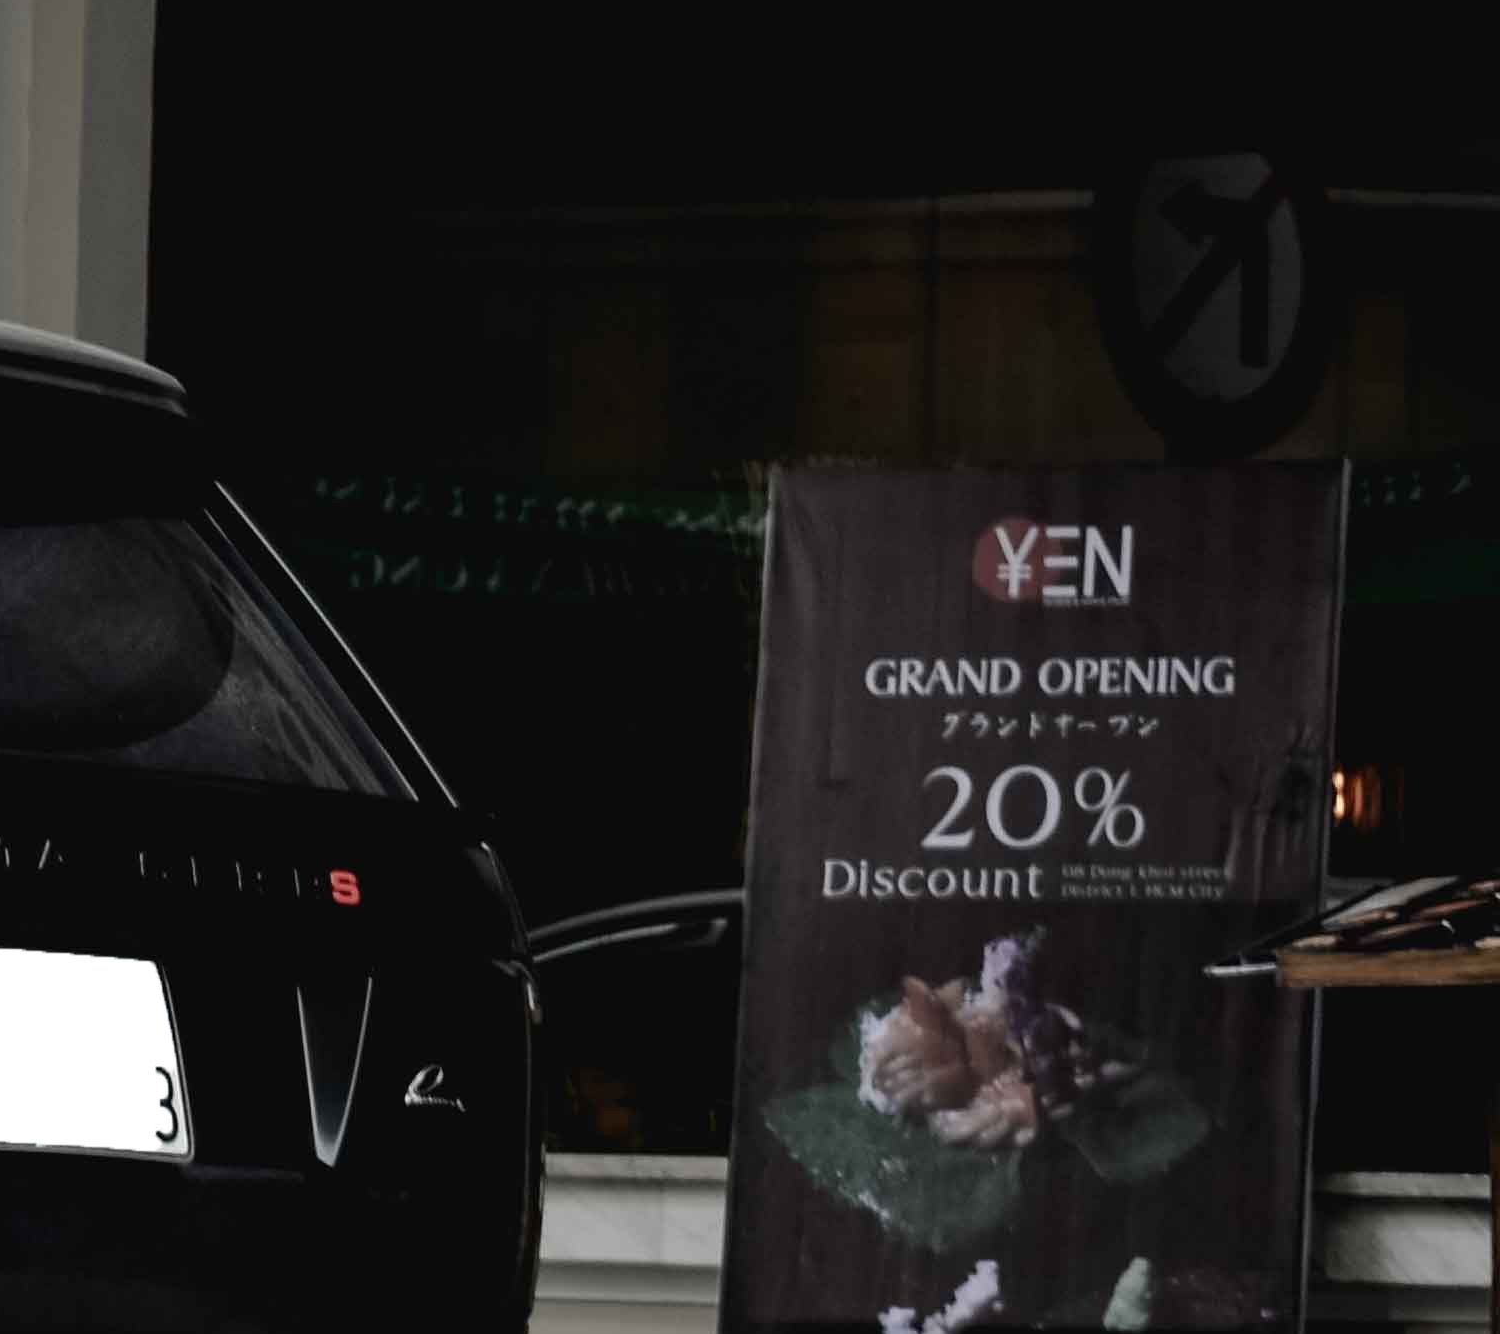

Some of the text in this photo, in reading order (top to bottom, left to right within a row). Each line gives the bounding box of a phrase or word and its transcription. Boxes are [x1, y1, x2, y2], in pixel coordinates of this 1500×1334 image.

[864, 655, 1236, 698] GRAND OPENING
[919, 763, 1147, 851] 20%
[820, 857, 1044, 900] Discount
